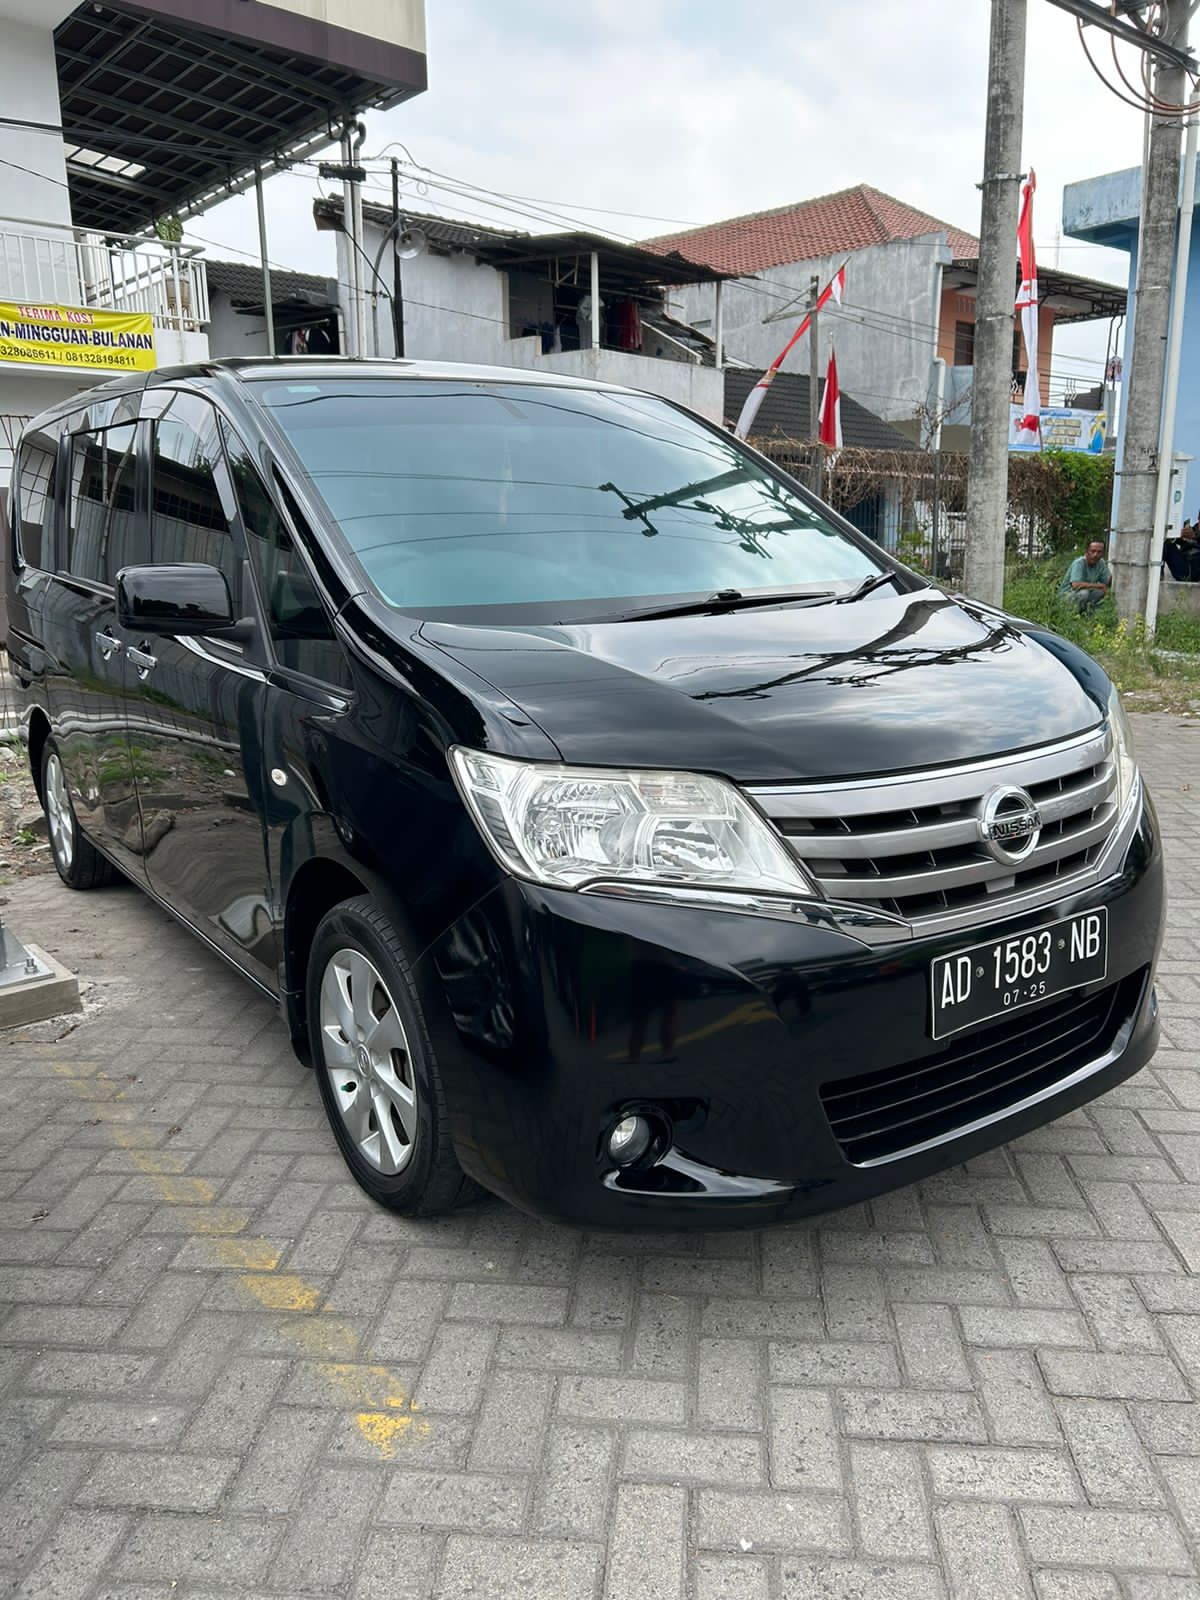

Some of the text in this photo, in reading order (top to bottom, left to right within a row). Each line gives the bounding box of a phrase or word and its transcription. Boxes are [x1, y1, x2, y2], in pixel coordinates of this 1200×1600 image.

[17, 305, 95, 324] TERIMA KOST
[0, 321, 153, 350] N-MINGGUAN-BULANAN
[65, 351, 136, 366] 081328194811
[992, 813, 1041, 836] NISSAN
[941, 915, 1100, 1009] AD 1583 NB
